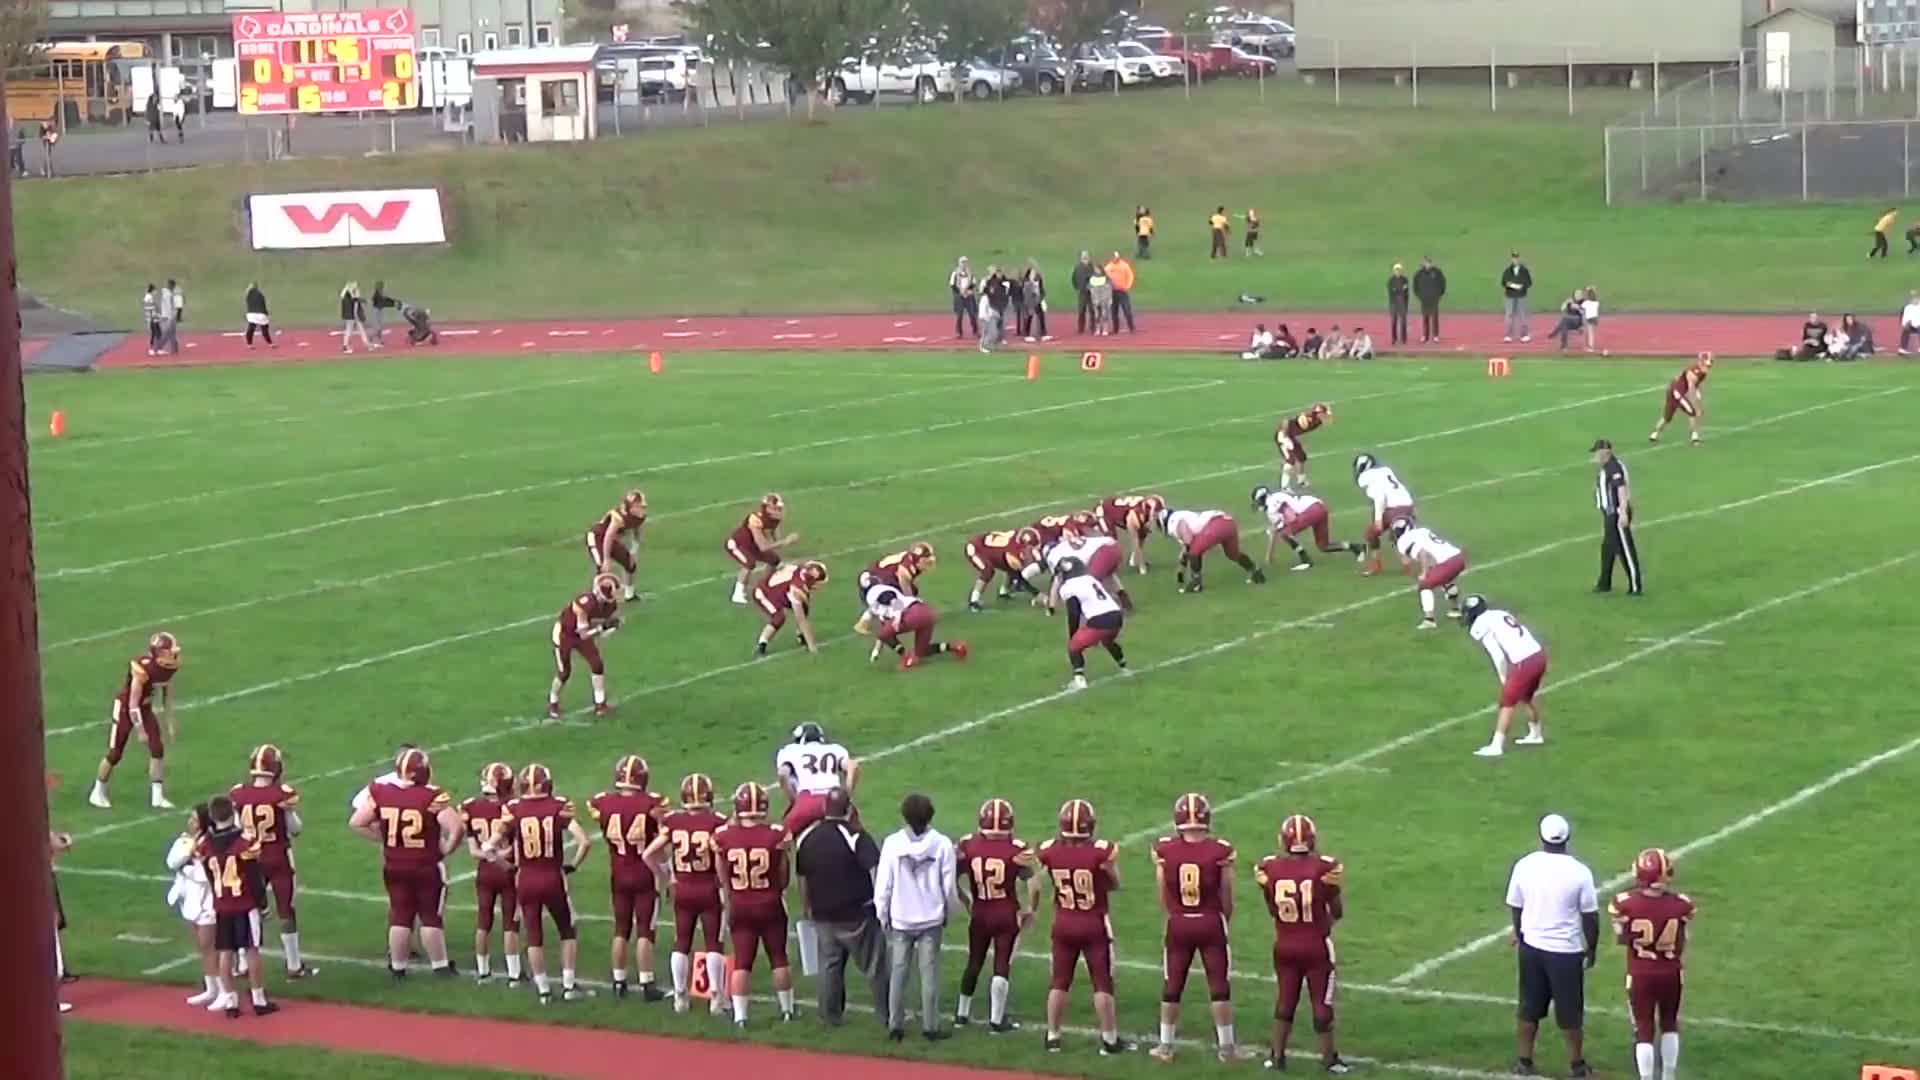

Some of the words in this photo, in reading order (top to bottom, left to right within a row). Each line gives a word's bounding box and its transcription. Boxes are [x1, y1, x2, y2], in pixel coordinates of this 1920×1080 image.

[266, 20, 380, 36] CARDINALS
[241, 43, 275, 55] HOME
[396, 53, 412, 78] 0
[254, 58, 271, 83] 0
[241, 87, 258, 113] 2
[802, 752, 838, 774] 30
[380, 807, 425, 848] 72
[520, 816, 554, 859] 81
[606, 814, 647, 855] 44
[672, 831, 711, 872] 23
[727, 848, 770, 890] 32
[208, 855, 242, 898] 14
[970, 857, 1005, 900] 12
[1052, 869, 1095, 911] 59
[1273, 879, 1313, 923] 61
[1630, 918, 1680, 960] 24
